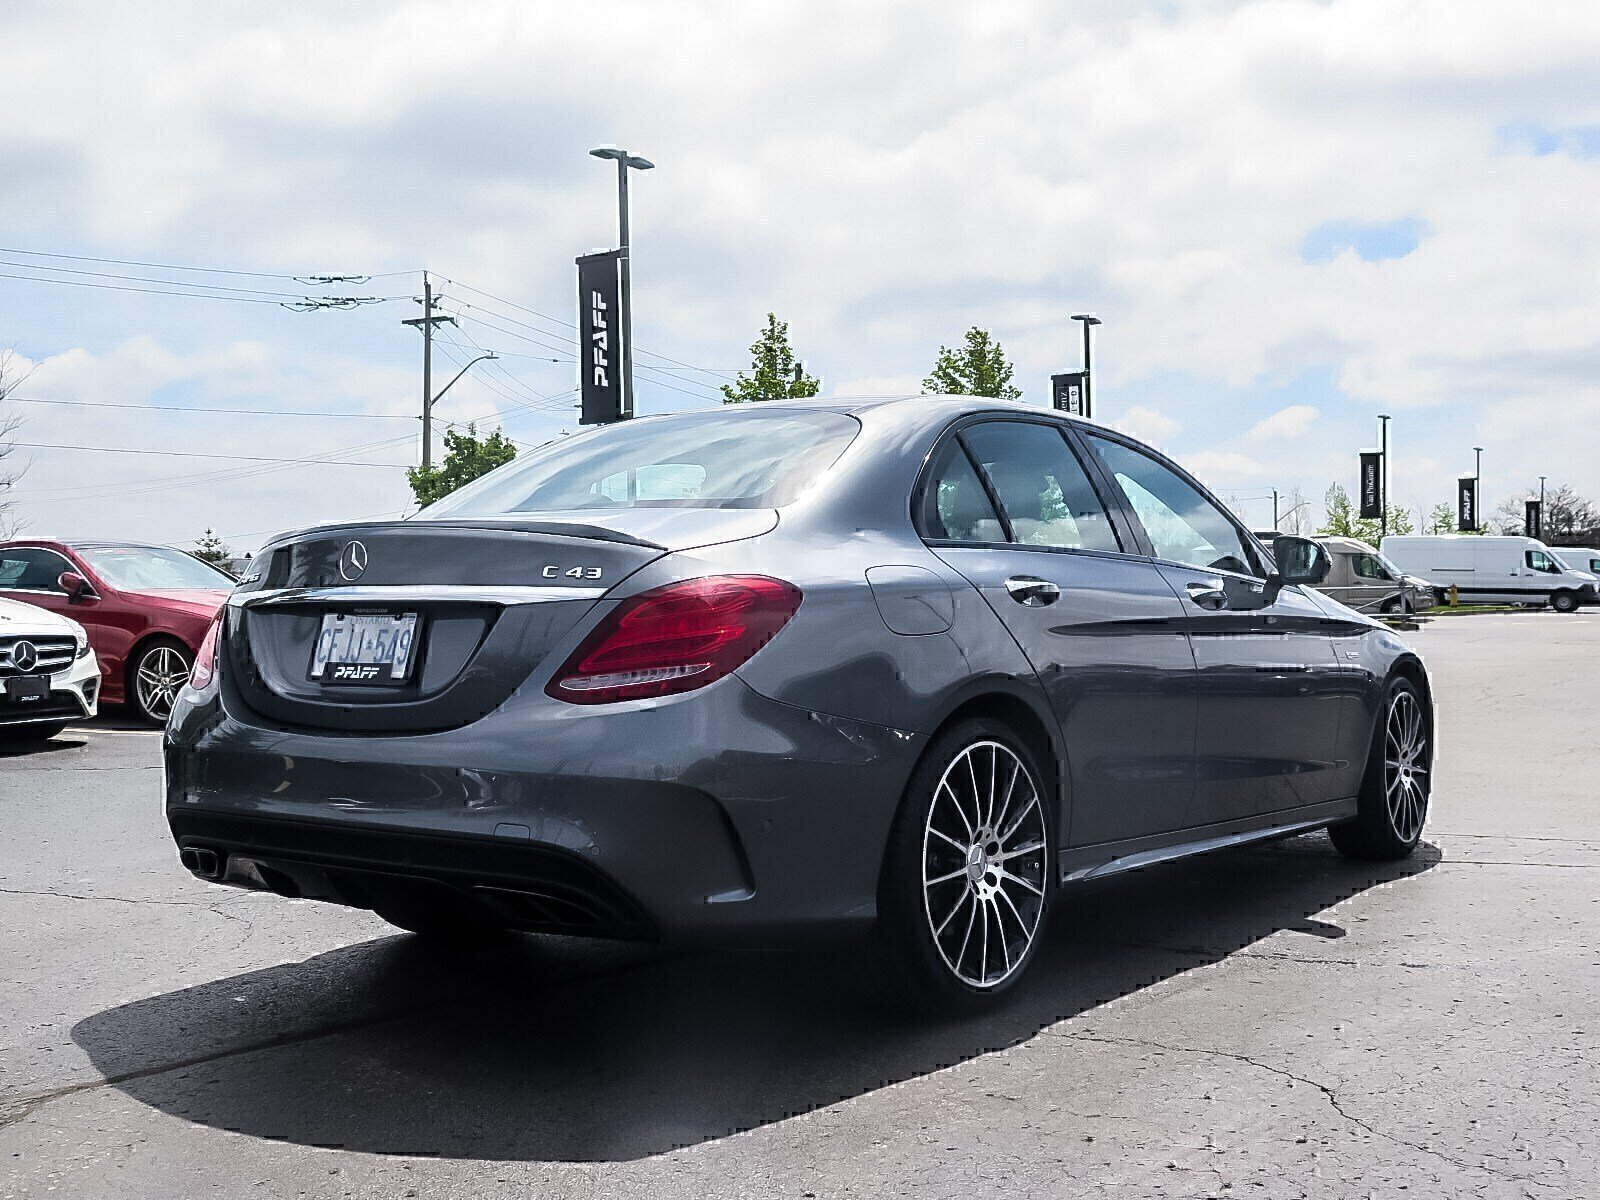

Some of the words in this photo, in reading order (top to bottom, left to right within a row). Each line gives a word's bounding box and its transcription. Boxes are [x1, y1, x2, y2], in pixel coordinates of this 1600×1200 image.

[592, 290, 609, 387] PFAFF
[542, 565, 559, 578] C
[565, 566, 602, 579] 43
[334, 666, 380, 679] PFAFF
